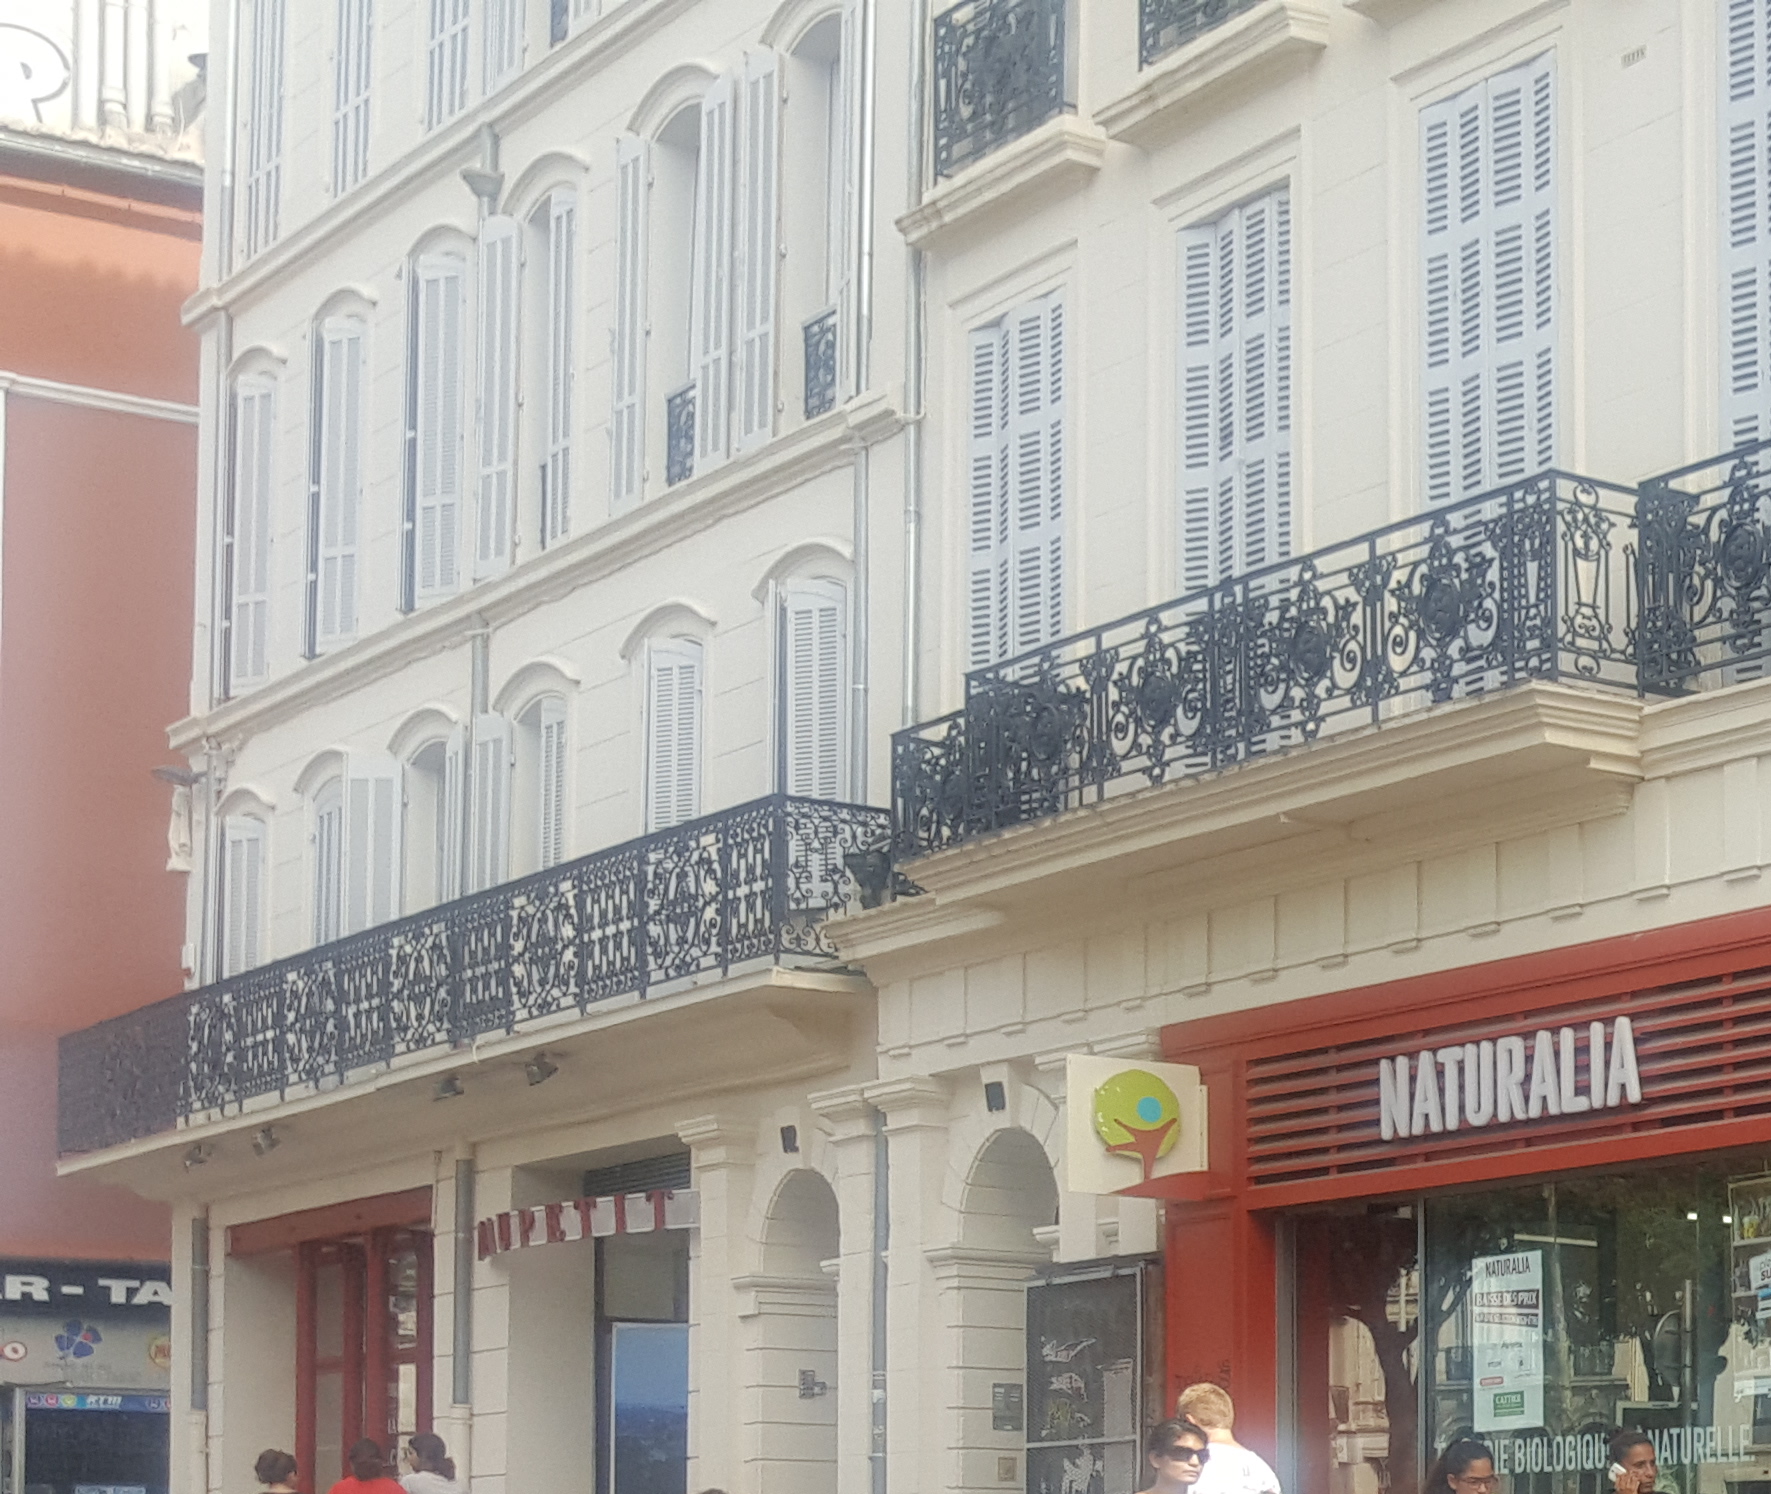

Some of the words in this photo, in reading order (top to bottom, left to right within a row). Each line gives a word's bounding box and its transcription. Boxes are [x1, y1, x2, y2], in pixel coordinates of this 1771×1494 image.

[1379, 1016, 1641, 1141] NATURALIA
[1485, 1256, 1531, 1278] NATURALIA
[0, 1275, 50, 1301] R
[1476, 1292, 1503, 1306] BAISSE
[1518, 1291, 1538, 1305] PRIX
